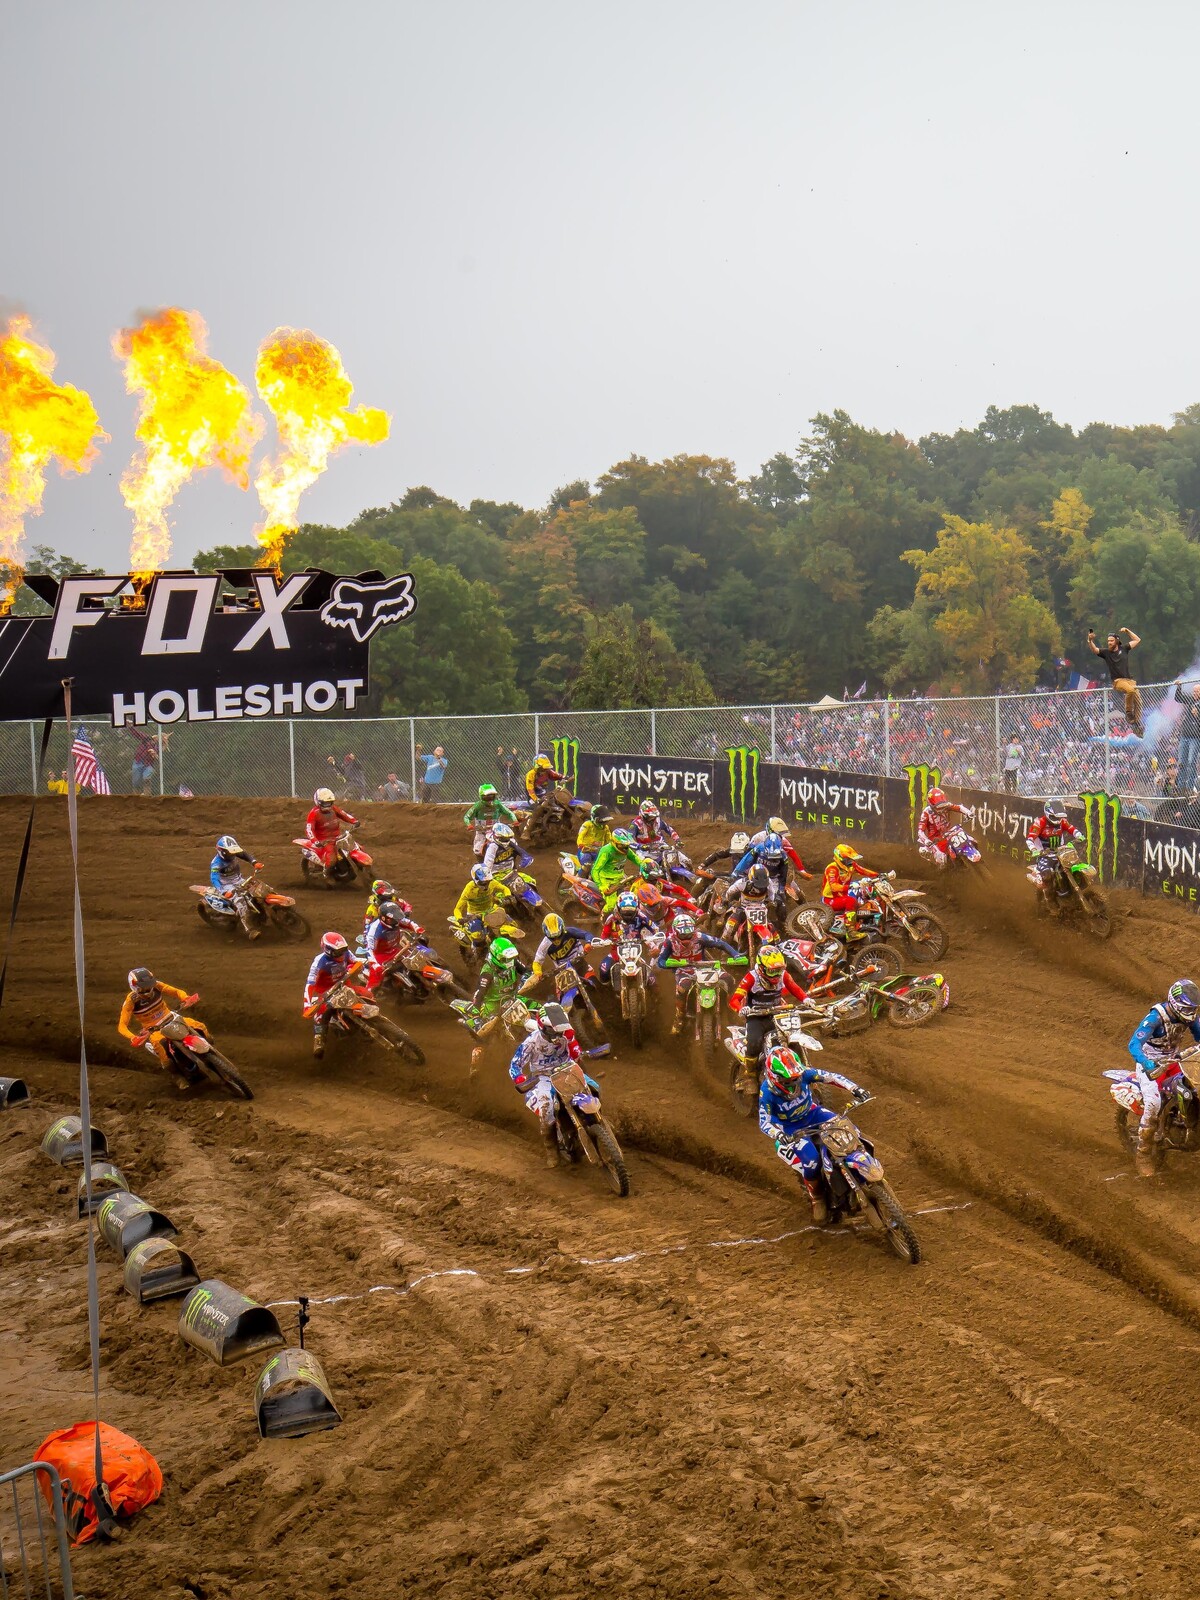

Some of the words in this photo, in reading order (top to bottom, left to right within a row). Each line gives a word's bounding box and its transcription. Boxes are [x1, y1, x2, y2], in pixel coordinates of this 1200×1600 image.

[48, 576, 313, 660] FOX
[113, 679, 364, 727] HOLESHOT
[600, 763, 712, 796] MONSTER
[780, 776, 882, 815] MONSTER
[796, 811, 867, 830] ENERGY
[750, 910, 765, 924] 58
[702, 971, 715, 981] 7
[780, 1016, 800, 1030] 59
[779, 1146, 795, 1160] 20
